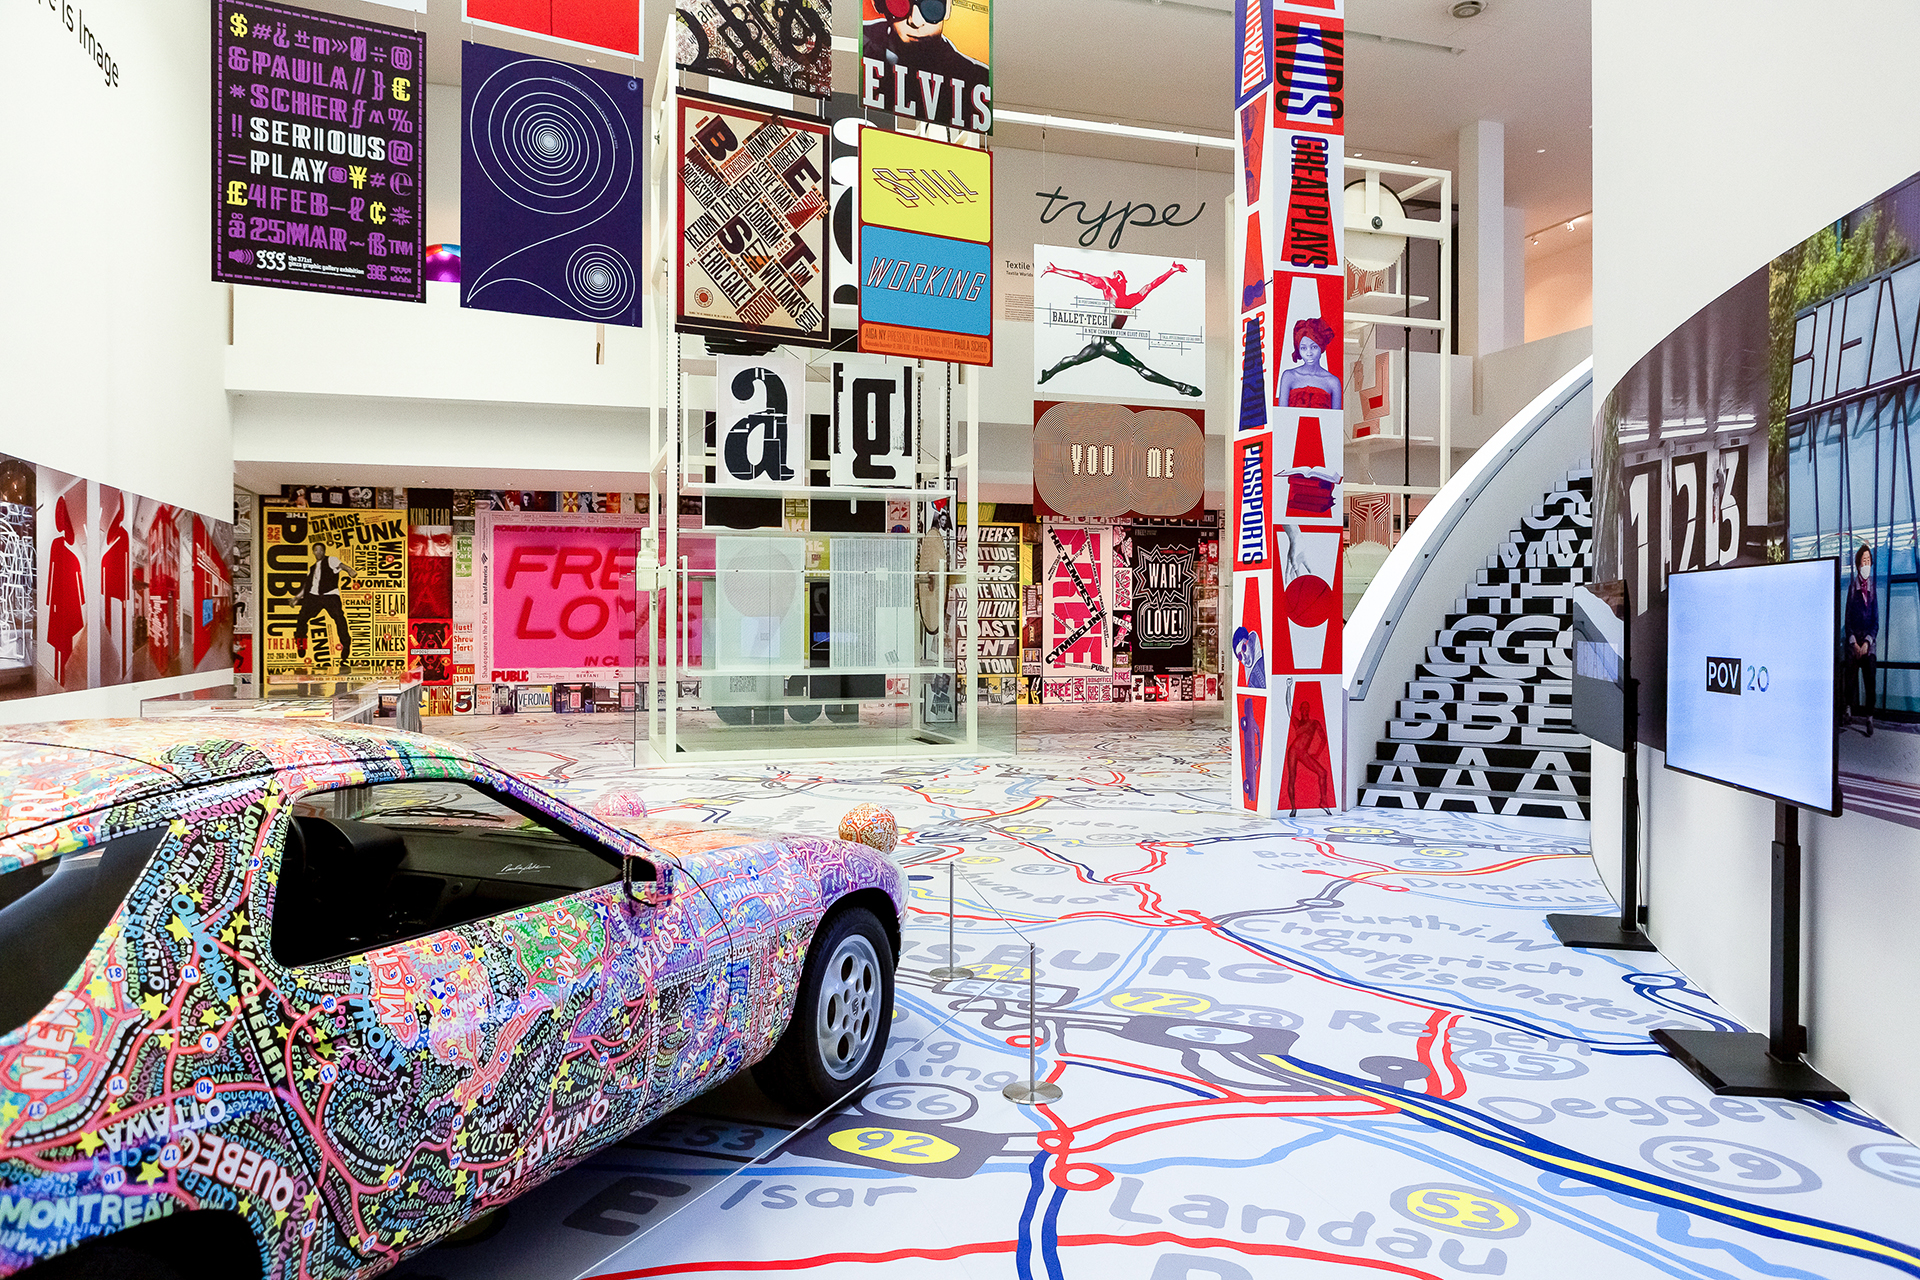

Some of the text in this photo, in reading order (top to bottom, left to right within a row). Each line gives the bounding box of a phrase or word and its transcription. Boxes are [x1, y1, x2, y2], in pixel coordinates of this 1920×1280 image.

[79, 8, 119, 88] Image
[252, 50, 348, 91] PAULA
[1275, 22, 1344, 121] KIDS
[250, 83, 348, 123] SCHER
[861, 57, 992, 133] ELVIS
[250, 117, 386, 161] SERIOUS
[769, 130, 816, 174] HUBERT LAWS
[250, 150, 329, 184] PLAY
[683, 162, 717, 209] ORCHESTRA
[871, 167, 979, 206] STILL
[752, 161, 796, 213] STEVE KHAN
[1290, 134, 1330, 270] GREAT PLAYS
[683, 174, 760, 250] RETURN TO FOREVER
[745, 202, 785, 248] COBHAM
[1035, 186, 1206, 250] type
[256, 250, 287, 271] ggg
[302, 262, 322, 271] graphic
[322, 264, 339, 273] gallery
[339, 267, 365, 275] exhibition
[698, 246, 754, 308] ERIC GALE
[866, 256, 987, 302] WORKING
[1005, 260, 1031, 271] Textile
[758, 260, 806, 318] WILLIAMS
[794, 302, 826, 334] SCOTT
[723, 366, 796, 481] a
[850, 377, 897, 480] g
[1070, 442, 1175, 480] YOU ME
[410, 507, 451, 526] KING LEAR
[1242, 440, 1264, 566] PASSPORTS
[341, 519, 407, 548] FUNK
[494, 525, 580, 534] ROMEO AND JULIET
[267, 512, 309, 637] PUBLIC
[355, 550, 367, 571] PLAYS
[367, 551, 378, 577] OTHER
[378, 541, 403, 579] WASP
[1047, 525, 1065, 553] THE
[1062, 552, 1098, 613] TEMPEST
[1149, 563, 1182, 589] WAR!
[340, 576, 403, 591] 2 WOMEN
[994, 583, 1017, 599] MEN
[382, 594, 406, 614] LEAR
[1147, 609, 1183, 635] LOVE!
[375, 637, 406, 652] KNEES
[1045, 607, 1108, 665] CYMBELINE
[491, 670, 529, 682] PUBLIC
[1707, 661, 1770, 692] POV 20
[454, 691, 473, 713] 5
[518, 692, 551, 707] VERONA
[181, 788, 265, 824] WINDSOR
[125, 834, 184, 939] ROCHESTER
[200, 841, 225, 911] MISSISSAUGA
[1233, 918, 1413, 944] Cham
[236, 934, 287, 1082] KITCHENER
[349, 964, 407, 1072] DETROIT
[20, 990, 87, 1091] NEW
[340, 1055, 381, 1079] ELGIN
[1468, 1049, 1552, 1077] 35
[100, 1100, 226, 1152] OTTAWA
[283, 1101, 321, 1173] WOODSTOCK
[856, 1130, 934, 1158] 92
[176, 1128, 295, 1212] QUEBEC
[344, 1159, 381, 1186] CHATHAM
[1669, 1145, 1783, 1182] 39
[418, 1180, 456, 1204] BARRIE
[720, 1179, 918, 1211] Isar
[1415, 1191, 1506, 1231] 53
[1108, 1176, 1508, 1276] Landau
